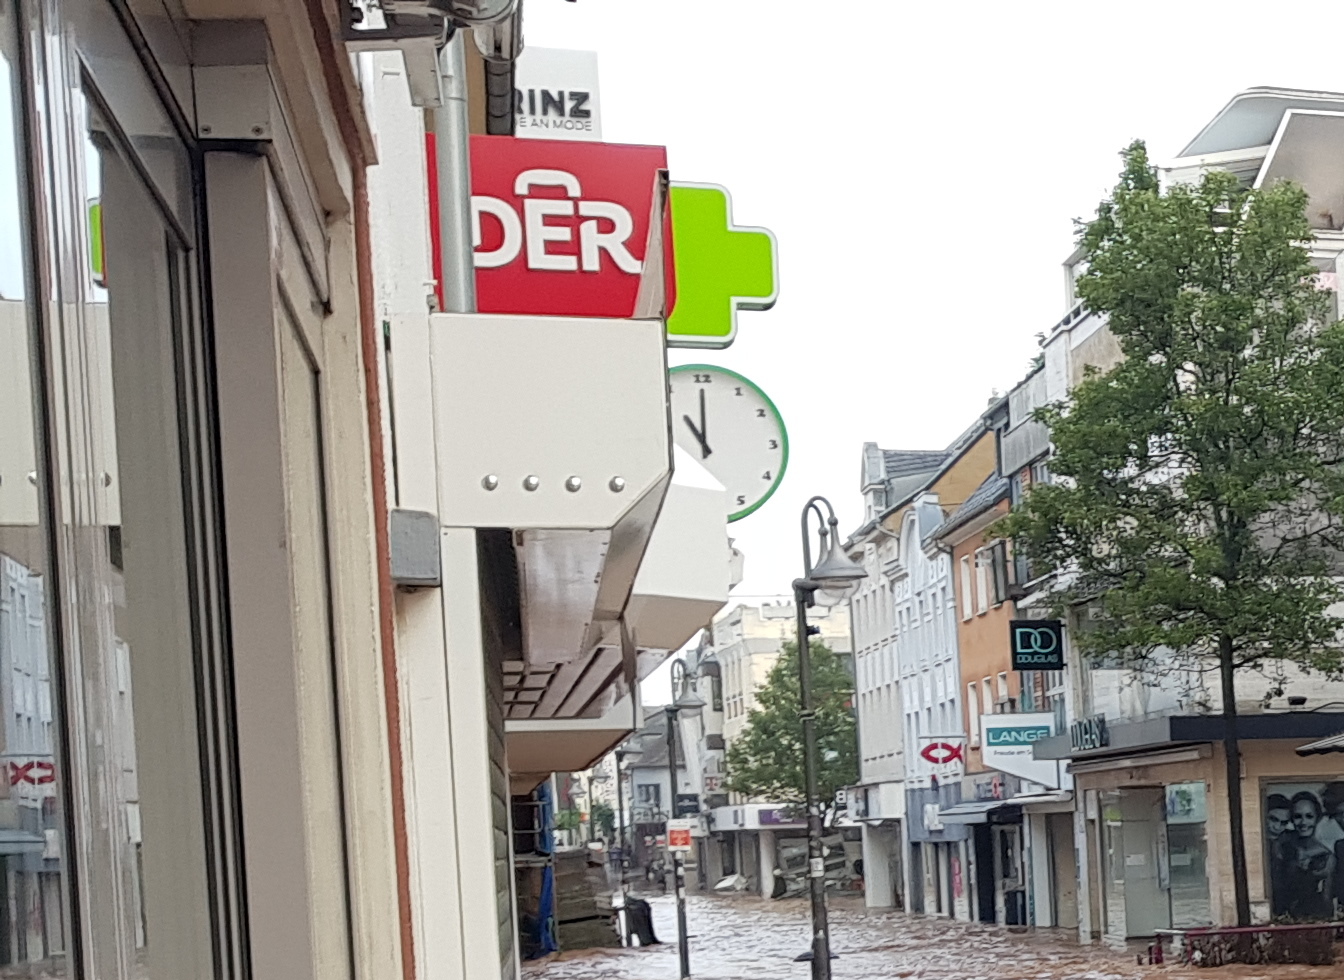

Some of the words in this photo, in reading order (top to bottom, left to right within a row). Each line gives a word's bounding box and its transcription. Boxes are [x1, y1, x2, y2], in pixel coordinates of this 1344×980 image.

[553, 120, 592, 131] MODE
[693, 374, 712, 384] 12
[734, 387, 743, 396] 1
[756, 408, 766, 418] 2
[768, 439, 778, 450] 3
[762, 471, 771, 481] 4
[737, 495, 745, 505] 5
[1016, 654, 1058, 664] DOUGLAS
